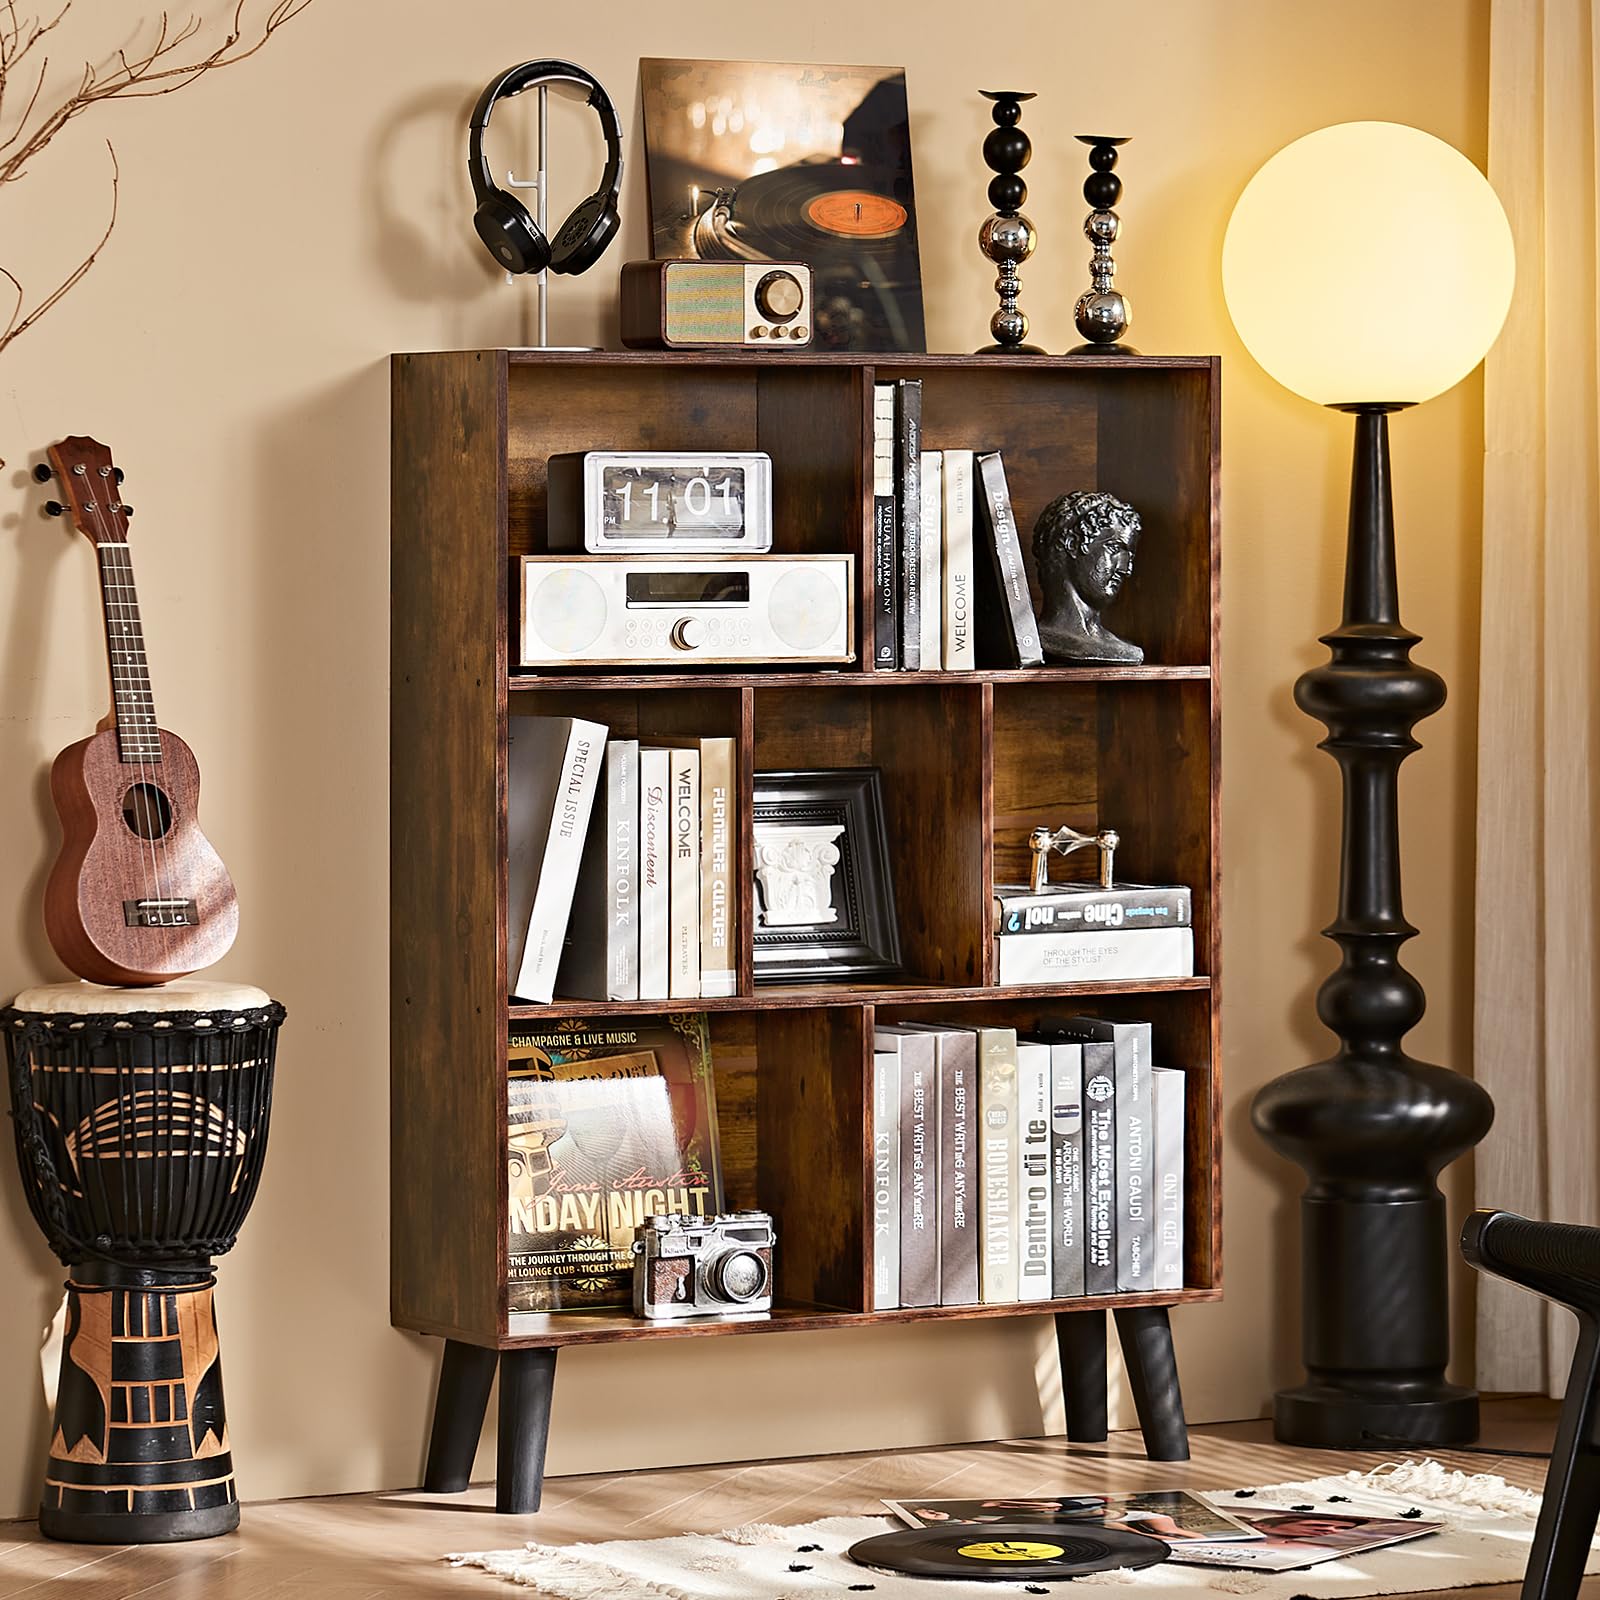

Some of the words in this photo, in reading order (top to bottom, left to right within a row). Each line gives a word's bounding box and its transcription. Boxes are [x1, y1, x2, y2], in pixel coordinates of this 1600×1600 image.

[604, 516, 616, 524] PM
[883, 505, 892, 548] VISUAL
[922, 494, 936, 545] Style
[908, 522, 916, 556] INTERIOR
[992, 490, 1011, 544] Design
[1011, 579, 1021, 601] century
[883, 553, 892, 614] HARMONY
[908, 558, 916, 586] DESIGN
[908, 587, 916, 615] REVIEW
[955, 574, 966, 652] WELCOME
[568, 740, 590, 795] SPECIAL
[559, 799, 578, 838] ISSUE
[678, 768, 691, 858] WELCOME
[712, 787, 725, 873] FURNITURE
[646, 786, 663, 888] Discontent
[615, 819, 630, 926] KINFOLK
[712, 880, 725, 947] CULTURE
[1008, 906, 1021, 931] ?
[1024, 906, 1054, 930] noi
[1083, 903, 1124, 926] Cine
[1043, 949, 1080, 957] THROUGH
[1098, 946, 1119, 955] EYES
[1055, 957, 1070, 965] THE
[1072, 955, 1101, 964] STYLIST
[512, 1035, 572, 1048] CHAMPAGNE
[574, 1034, 581, 1045] &
[583, 1033, 604, 1045] LIVE
[606, 1032, 637, 1044] MUSIC
[913, 1071, 923, 1086] THE
[954, 1070, 964, 1085] THE
[913, 1088, 924, 1120] BEST
[954, 1087, 965, 1119] BEST
[1024, 1119, 1047, 1144] te
[1098, 1109, 1111, 1141] The
[1128, 1116, 1142, 1172] ANTONI
[1024, 1153, 1047, 1177] di
[1062, 1140, 1072, 1184] AROUND
[1090, 1166, 1098, 1196] Tragedy
[1098, 1145, 1111, 1186] Most
[526, 1169, 601, 1209] Jane
[875, 1132, 890, 1236] KINFOLK
[986, 1138, 1009, 1265] BONESHAKER
[1063, 1185, 1072, 1207] THE
[1128, 1175, 1145, 1222] GAUDÍ
[1163, 1173, 1177, 1211] LIND
[508, 1192, 600, 1234] NDAY
[609, 1187, 710, 1229] NIGHT
[1063, 1209, 1073, 1247] WORLD
[1097, 1189, 1111, 1267] Excellent
[1023, 1186, 1047, 1277] Dentro
[1163, 1220, 1179, 1248] JED
[509, 1257, 527, 1267] THE
[528, 1254, 566, 1266] JOURNEY
[567, 1252, 608, 1263] THROUGH
[609, 1251, 626, 1261] THE
[518, 1267, 552, 1277] LOUNGE
[553, 1265, 575, 1275] CLUB
[581, 1263, 614, 1274] TICKETS
[1131, 1235, 1140, 1277] TASCHEN
